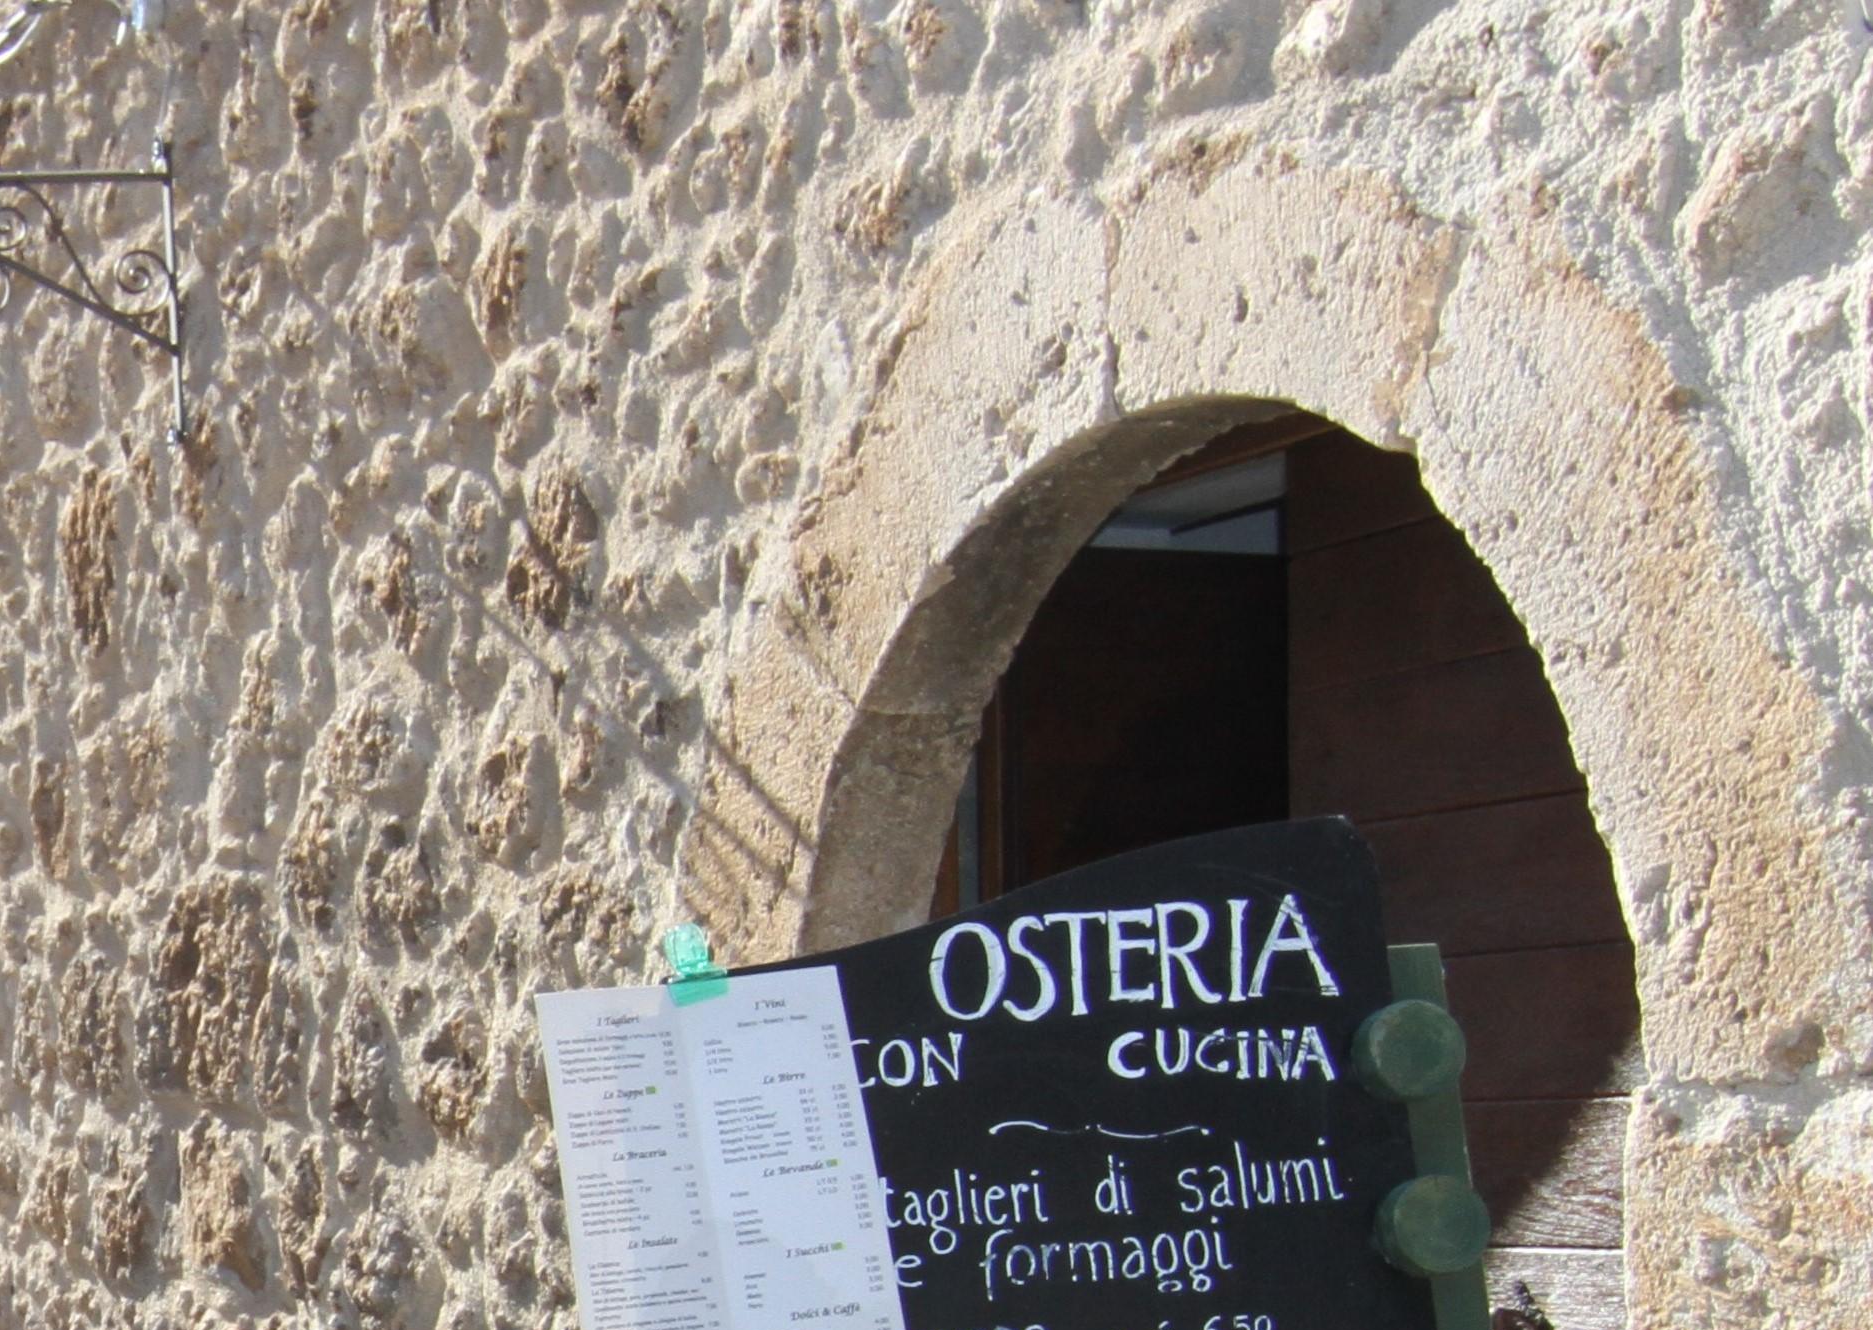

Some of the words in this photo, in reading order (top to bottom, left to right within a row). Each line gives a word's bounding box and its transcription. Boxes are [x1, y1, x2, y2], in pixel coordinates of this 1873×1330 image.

[929, 893, 1340, 1022] OSTERIA
[1107, 1025, 1337, 1081] CUCINA
[777, 1068, 806, 1083] Birre
[616, 1085, 644, 1102] Zuppe
[625, 1145, 667, 1161] Braceria
[777, 1159, 824, 1176] Bevande
[879, 1167, 1049, 1255] taglieri
[1094, 1154, 1133, 1215] di
[1177, 1136, 1345, 1213] salumi
[639, 1233, 678, 1248] Insalate
[792, 1242, 829, 1257] Succhi
[894, 1254, 923, 1288] e
[978, 1216, 1234, 1301] formaggi
[789, 1307, 819, 1321] Dolci
[821, 1306, 830, 1316] &
